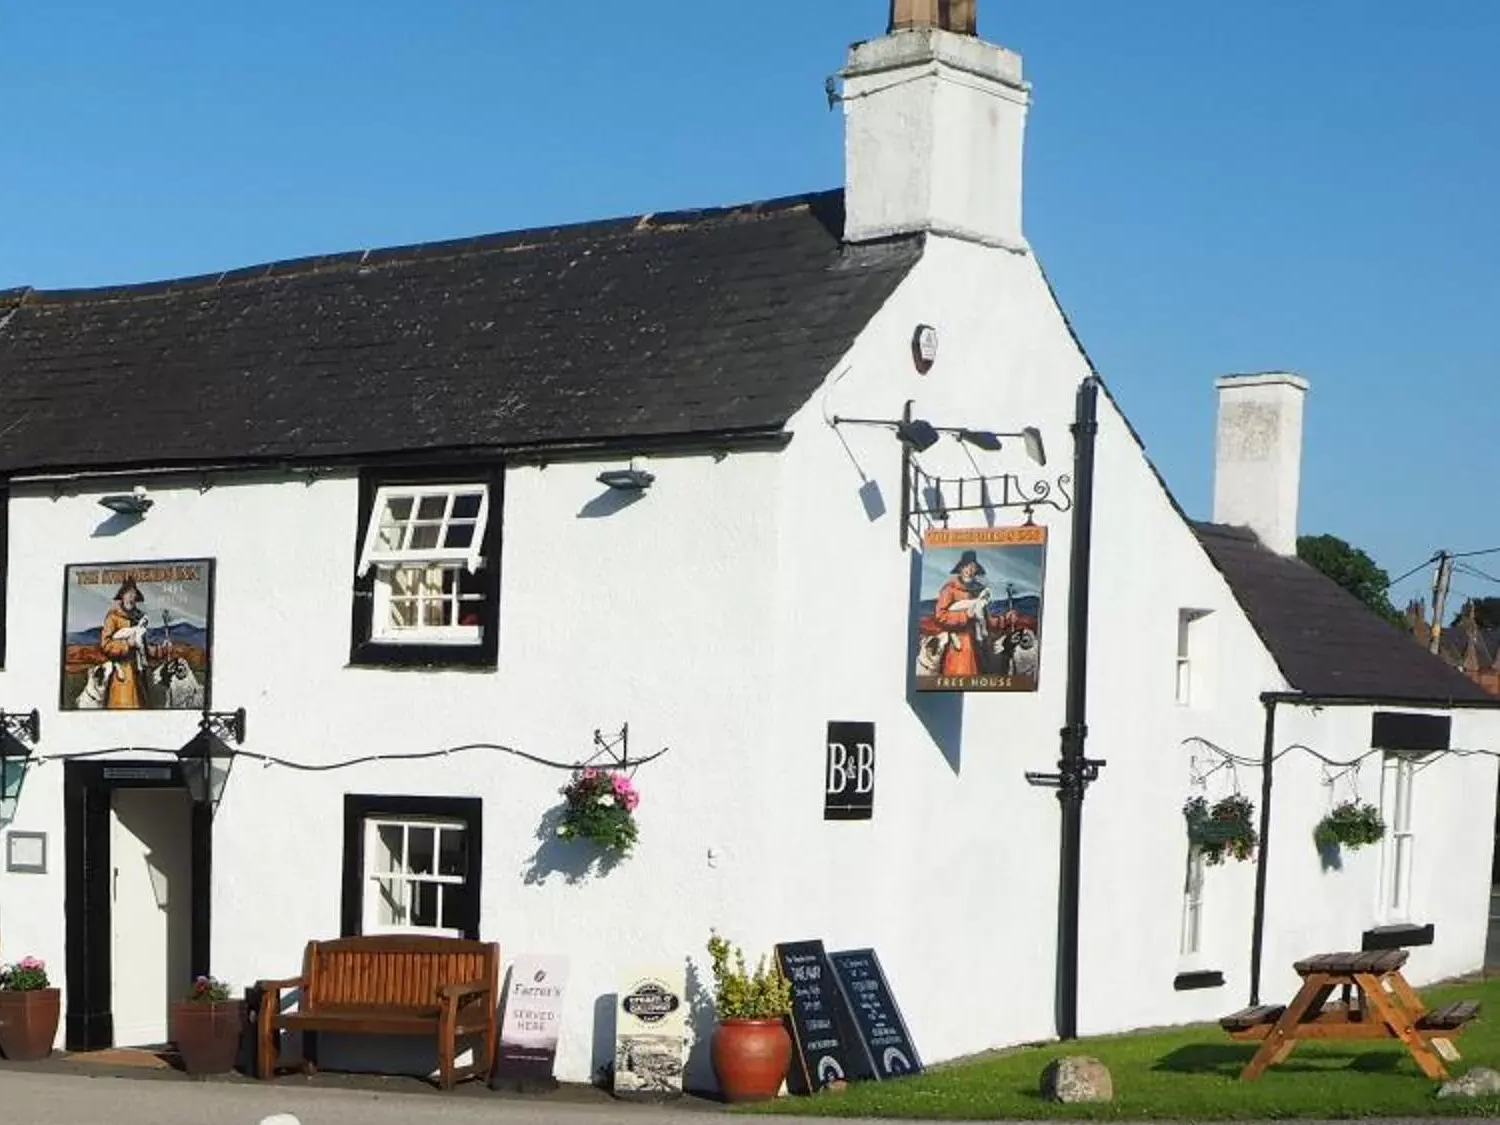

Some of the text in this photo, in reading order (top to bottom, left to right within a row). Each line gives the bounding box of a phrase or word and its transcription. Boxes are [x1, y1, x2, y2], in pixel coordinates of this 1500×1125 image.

[936, 676, 1013, 688] FREE HOUSE
[827, 743, 874, 793] B&B
[517, 1020, 547, 1031] HERE
